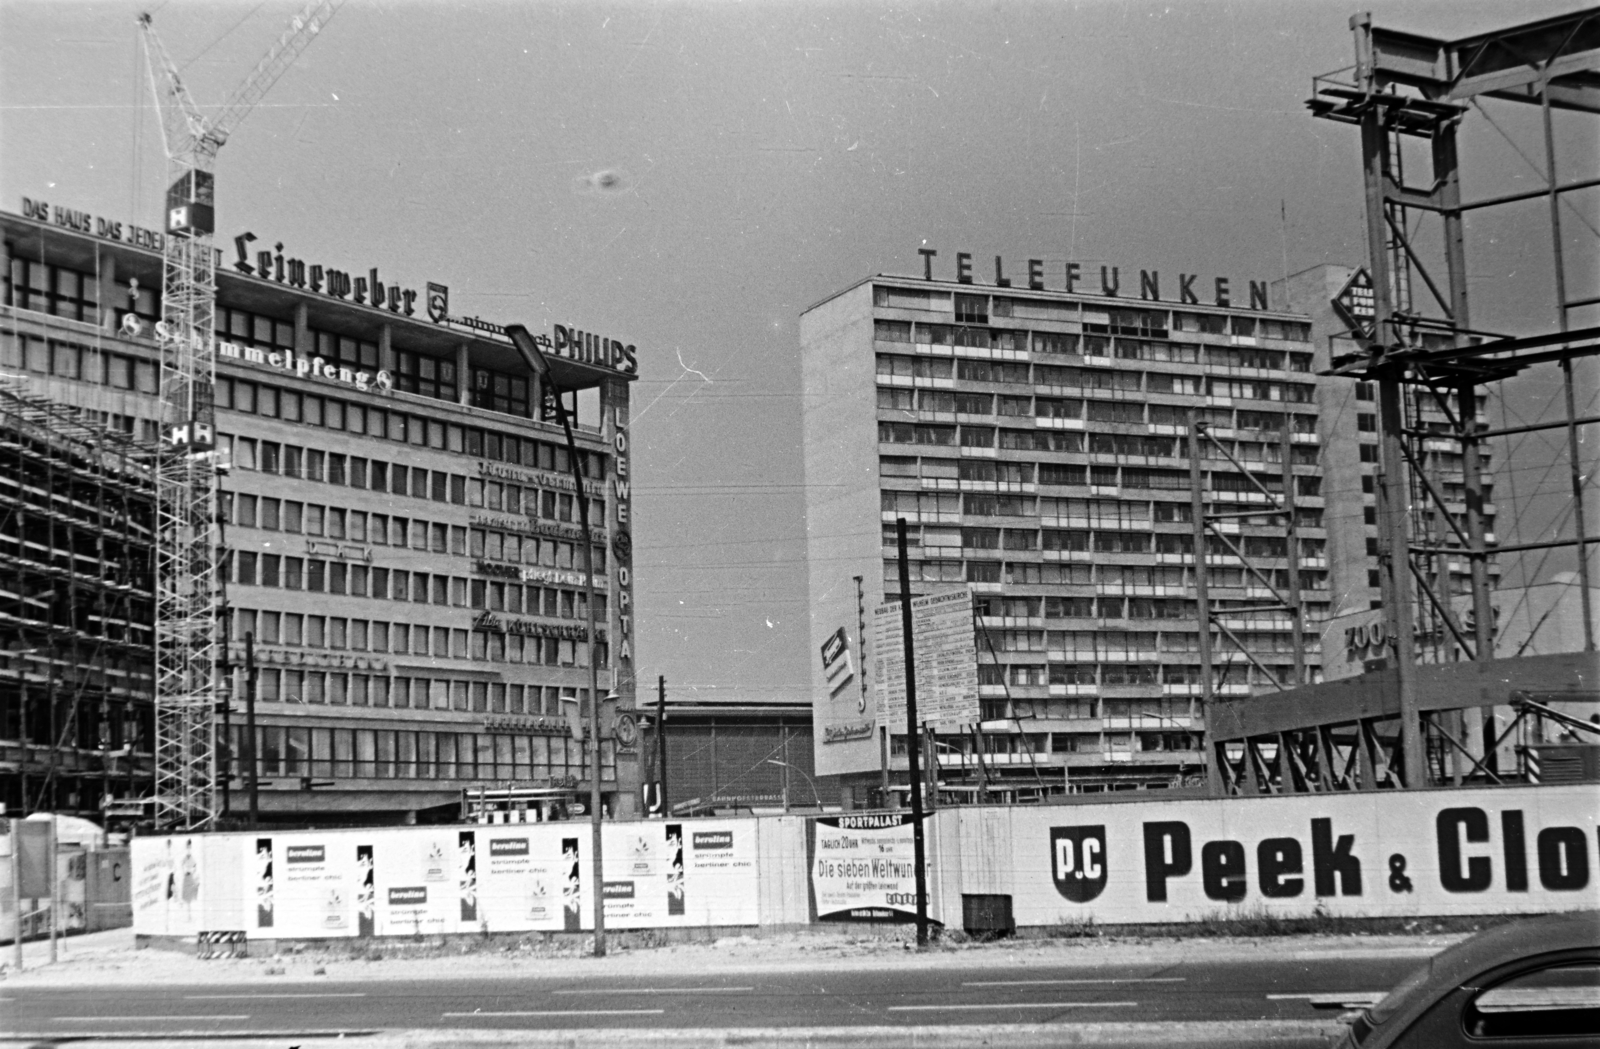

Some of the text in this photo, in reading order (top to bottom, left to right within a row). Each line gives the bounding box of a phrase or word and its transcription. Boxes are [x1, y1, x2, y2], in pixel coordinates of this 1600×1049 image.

[22, 197, 49, 221] DAS
[55, 206, 92, 233] HAUS
[97, 217, 122, 241] DAS
[917, 248, 1269, 310] TELEFUNKEN
[154, 320, 370, 391] Schmmelpfeng
[554, 324, 639, 374] PHILIPS
[838, 815, 903, 829] SPORTPALAST
[492, 841, 527, 851] berolina
[695, 834, 730, 845] berolina
[841, 836, 849, 849] 20
[849, 838, 859, 849] UHR
[288, 848, 323, 859] berolina
[1142, 806, 1600, 903] Peek & Clo
[818, 858, 932, 878] Die sieben Weltwunr
[390, 890, 426, 900] berolina
[603, 885, 633, 894] erolina
